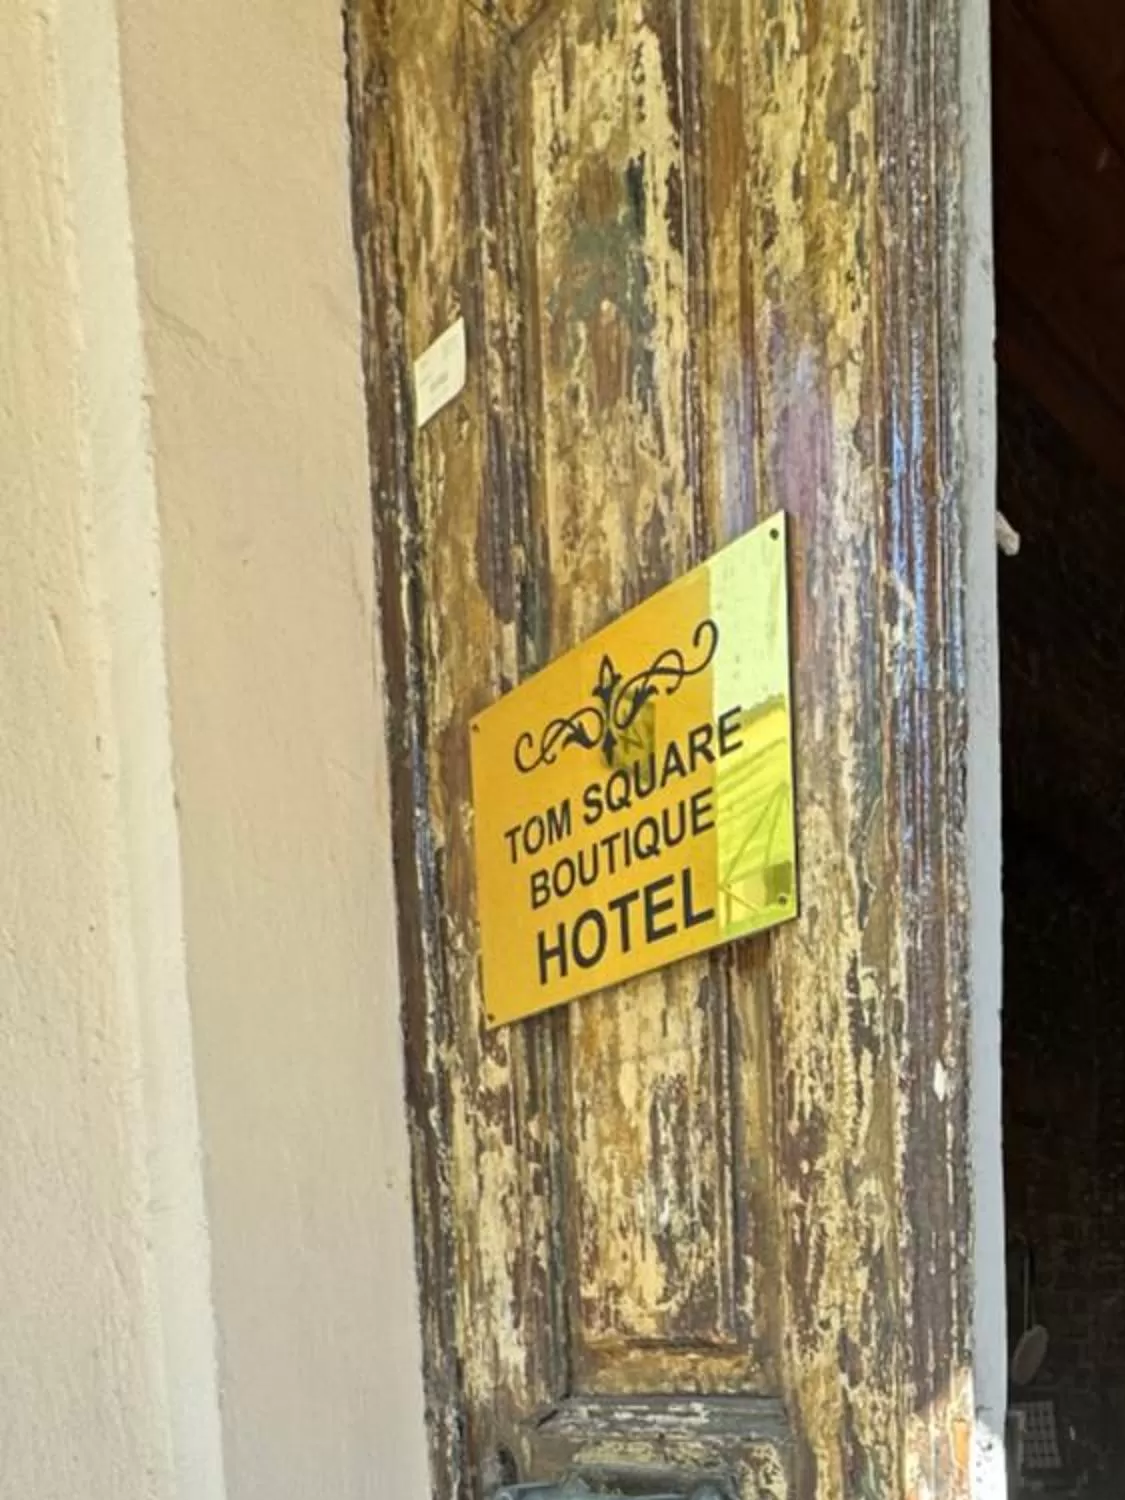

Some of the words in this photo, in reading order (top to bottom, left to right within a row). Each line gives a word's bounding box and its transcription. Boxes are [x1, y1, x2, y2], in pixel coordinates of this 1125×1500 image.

[504, 800, 572, 864] TOM
[582, 706, 744, 823] SQUARE
[530, 788, 716, 910] BOUTIQUE
[537, 867, 716, 986] HOTEL
